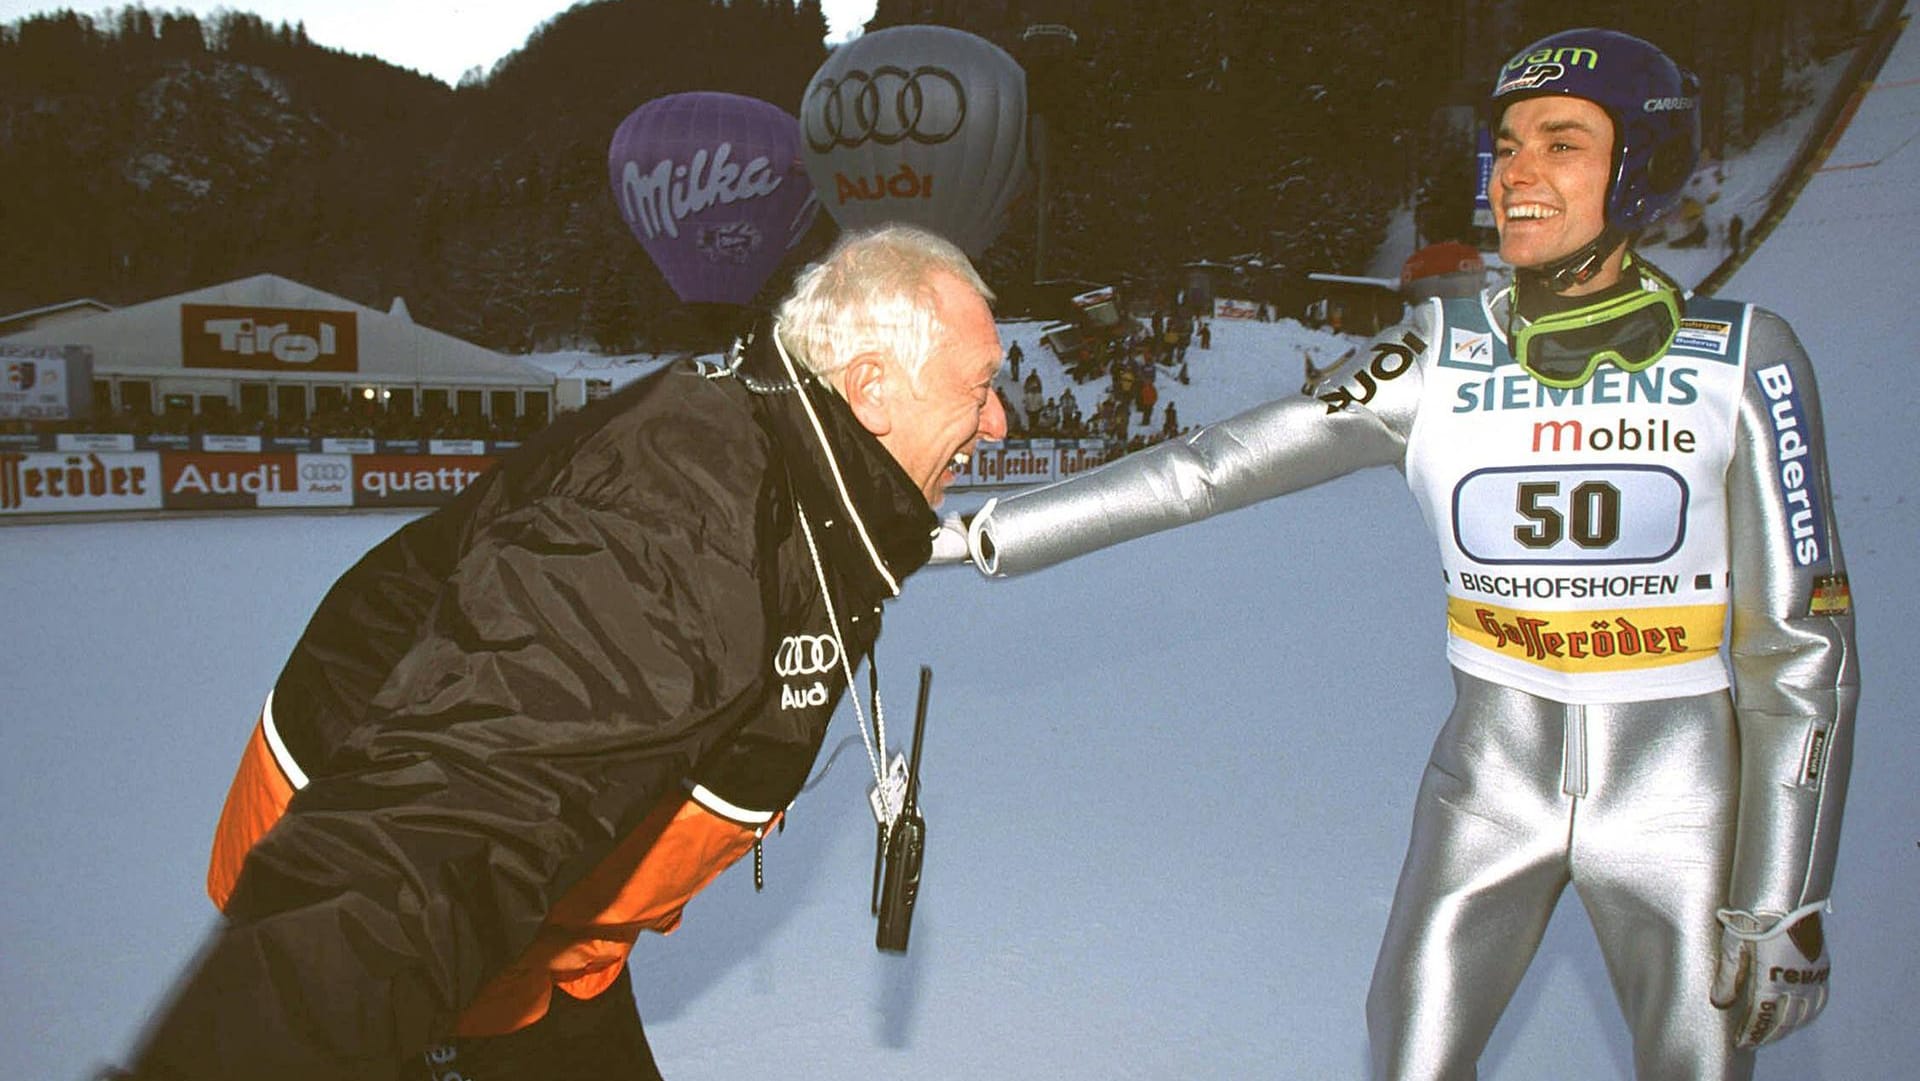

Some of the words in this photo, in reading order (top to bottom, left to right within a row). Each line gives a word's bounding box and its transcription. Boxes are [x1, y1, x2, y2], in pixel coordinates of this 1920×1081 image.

[622, 143, 782, 239] Milka
[834, 163, 933, 205] Audi
[203, 318, 336, 363] Tirol
[1453, 366, 1699, 413] SIEMENS
[1532, 418, 1697, 454] mobile
[172, 464, 282, 496] Audi
[1759, 363, 1820, 567] Buderus
[1513, 480, 1621, 550] 50
[1461, 573, 1680, 599] BISCHOFSHOFEN
[1476, 609, 1690, 661] Hasseröder
